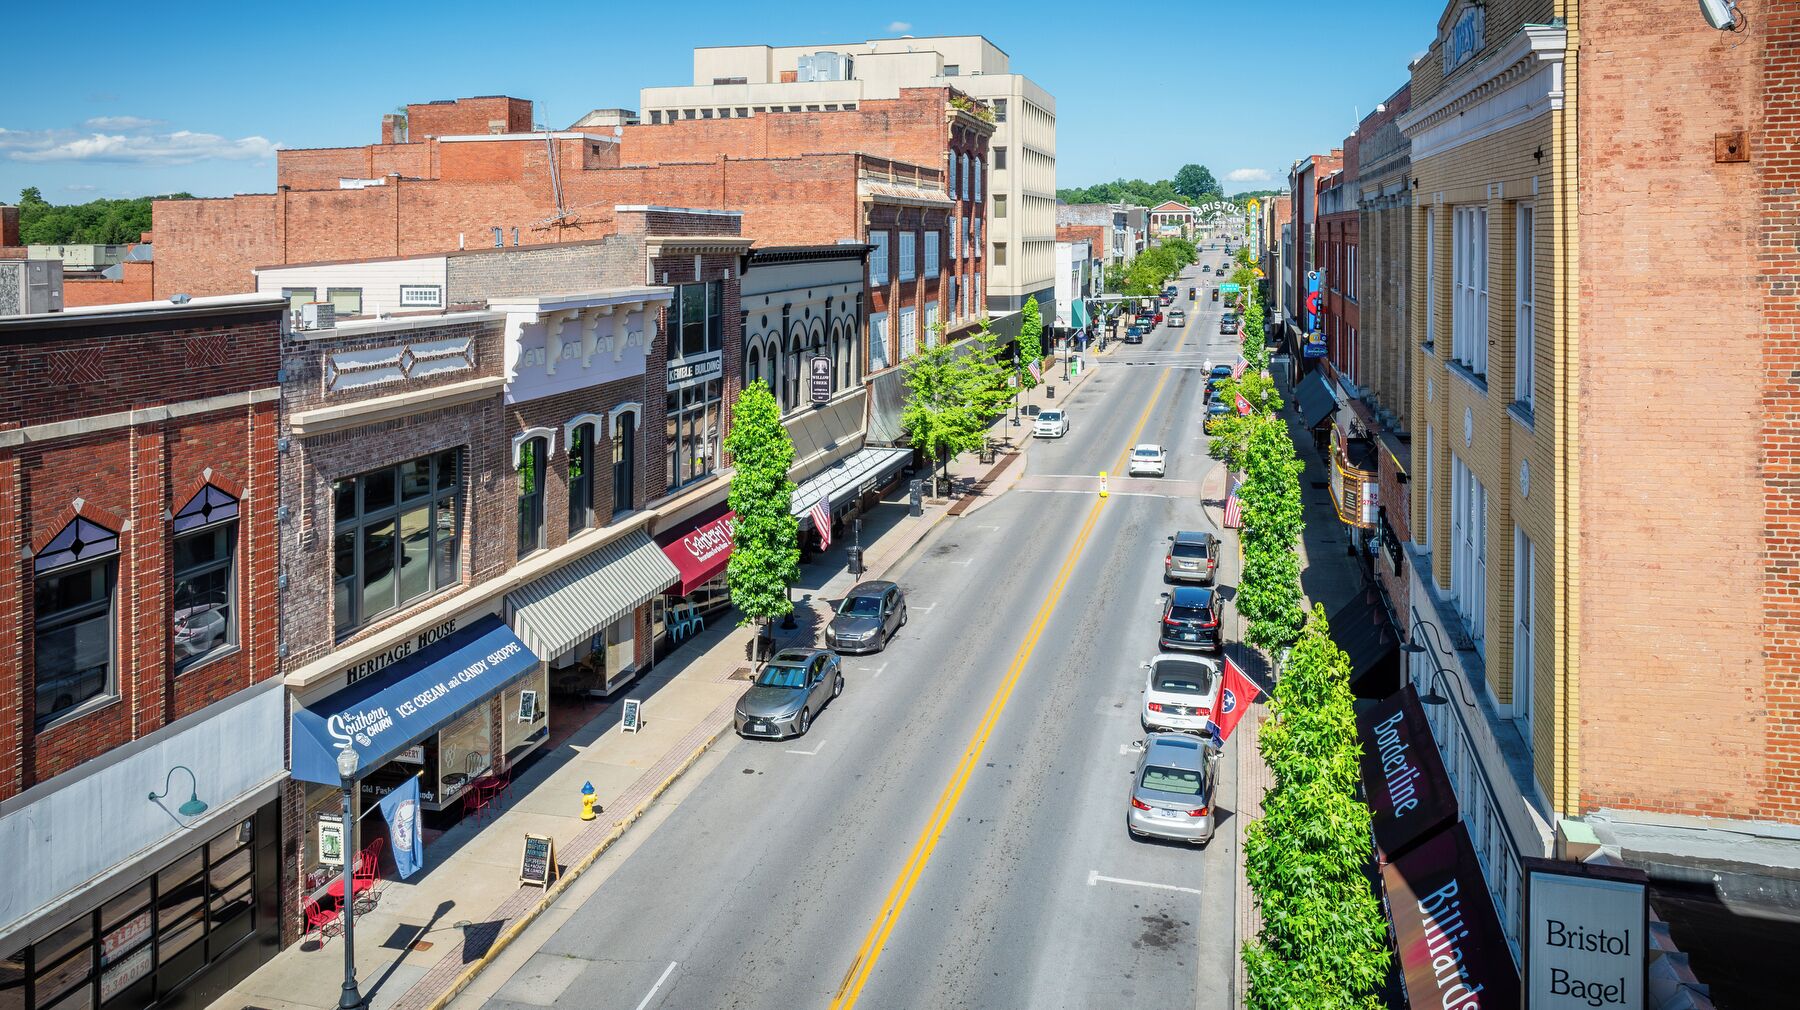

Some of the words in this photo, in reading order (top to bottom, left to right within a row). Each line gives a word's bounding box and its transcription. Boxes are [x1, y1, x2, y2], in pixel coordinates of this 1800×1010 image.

[1195, 201, 1240, 217] BRISTOL
[1250, 204, 1258, 261] PARAMOUNT
[669, 366, 693, 381] KEMBLE
[695, 360, 720, 375] BUILDING
[684, 525, 731, 556] Cranberry
[346, 640, 411, 685] HERITAGE
[417, 618, 457, 650] HOUSE
[395, 701, 417, 719] ICE
[413, 682, 450, 708] CREAM
[448, 676, 461, 689] and
[457, 659, 489, 683] CANDY
[486, 641, 522, 666] SHOPPE
[327, 706, 388, 748] Southern
[343, 711, 357, 722] the
[366, 715, 393, 737] CHURN
[1373, 710, 1419, 818] Borderline
[1546, 919, 1631, 956] Bristol
[1549, 967, 1627, 1006] Bagel
